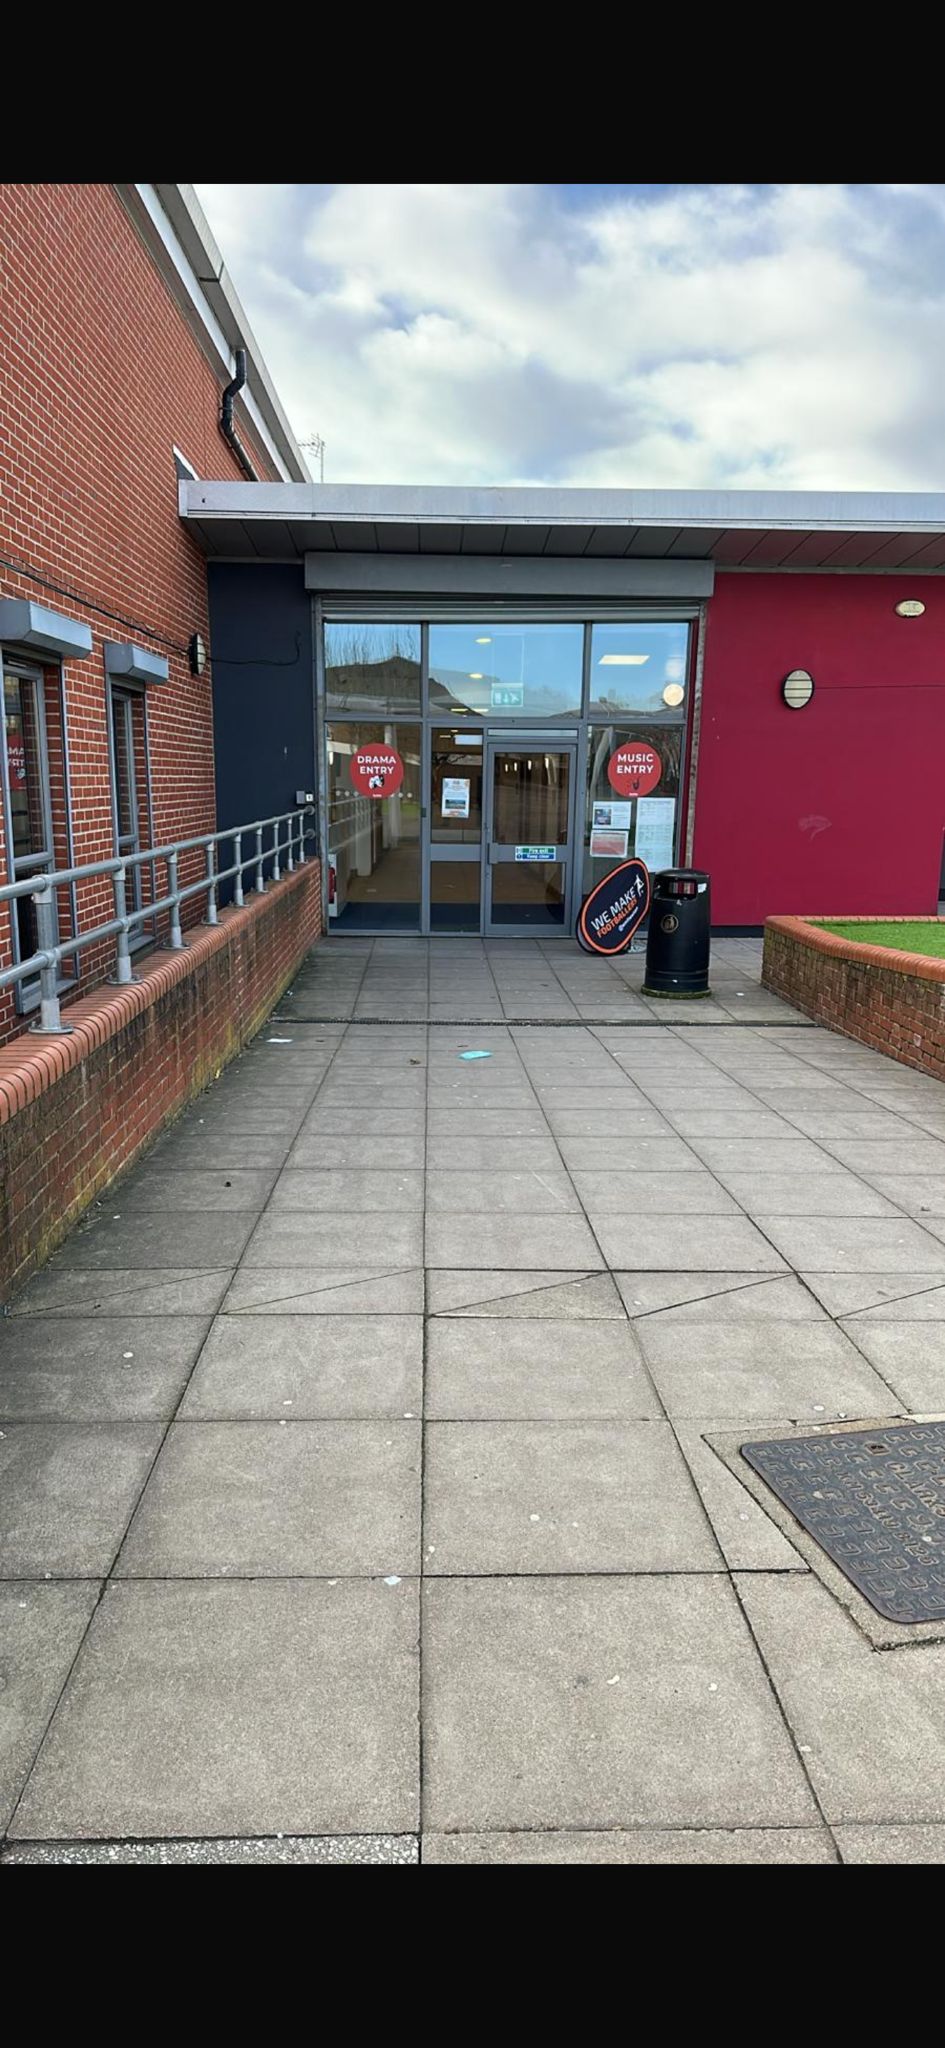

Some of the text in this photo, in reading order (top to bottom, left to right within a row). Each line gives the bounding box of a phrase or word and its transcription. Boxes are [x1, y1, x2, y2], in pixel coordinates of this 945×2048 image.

[357, 755, 397, 764] DRAMA
[617, 753, 654, 763] MUSIC
[359, 766, 394, 775] ENTRY
[616, 765, 654, 774] ENTRY
[590, 910, 611, 930] WE
[610, 886, 636, 917] MAKE
[596, 898, 638, 938] FOOTBALLERS
